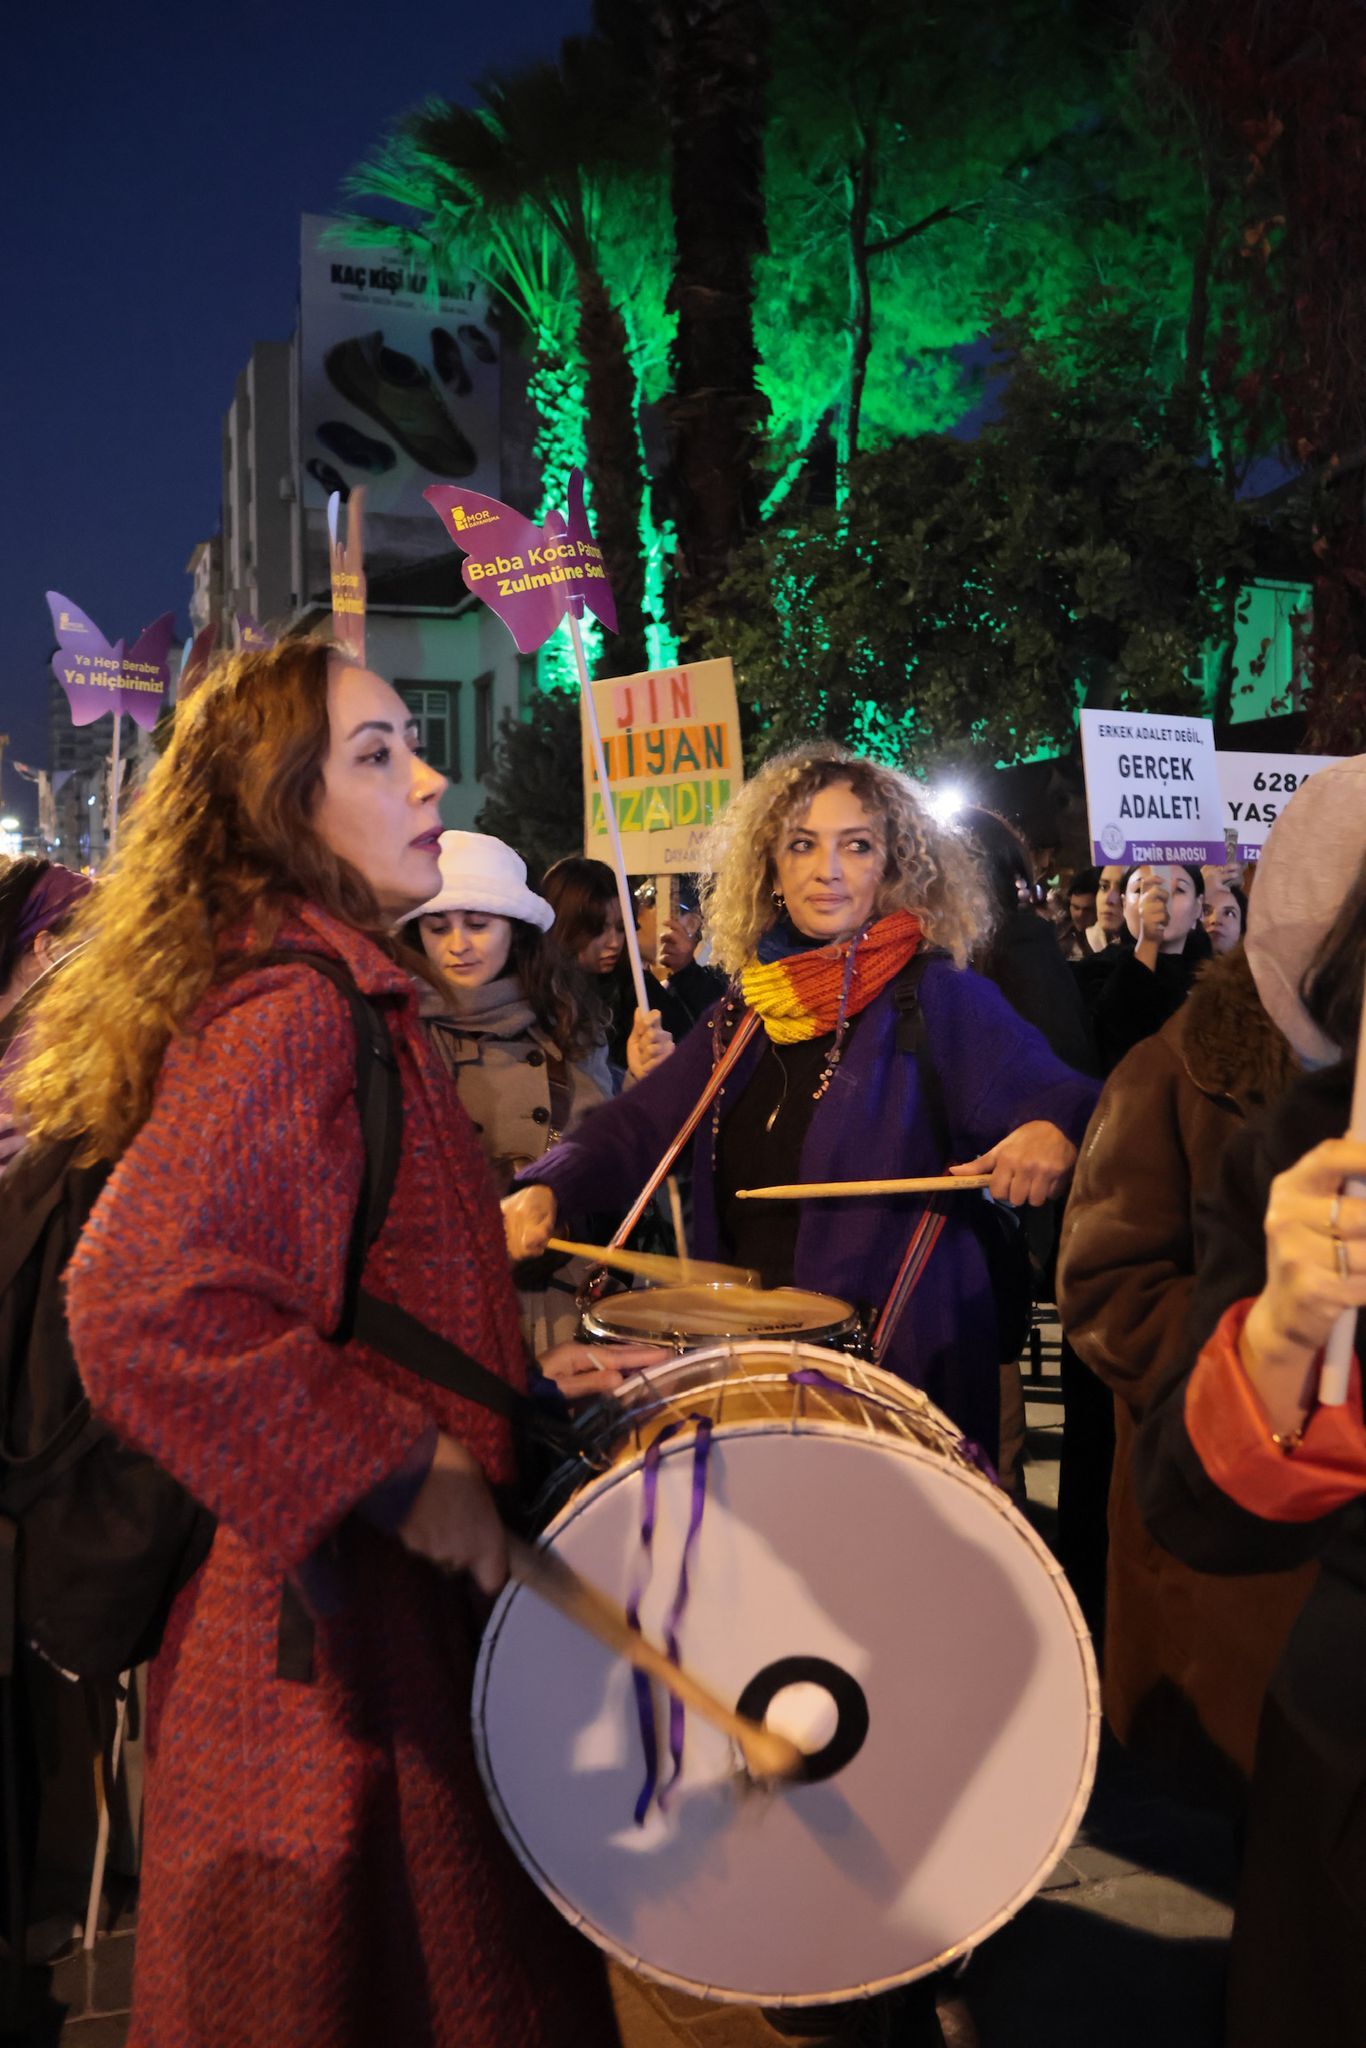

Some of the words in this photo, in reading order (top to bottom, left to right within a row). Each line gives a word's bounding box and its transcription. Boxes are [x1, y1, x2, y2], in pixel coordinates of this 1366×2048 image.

[331, 264, 366, 291] KAÇ
[466, 510, 490, 523] MOR
[467, 554, 524, 581] Baba
[528, 543, 576, 567] Koca
[497, 564, 584, 597] Zulmüne
[64, 669, 85, 685] Ya
[75, 654, 91, 666] Ya
[94, 657, 120, 670] Hep
[122, 659, 160, 675] Beraber
[617, 672, 692, 729] JIN
[1098, 724, 1135, 739] ERKEK
[1136, 727, 1172, 741] ADALET
[1118, 754, 1195, 786] GERÇEK
[1119, 794, 1200, 820] ADALET!
[1132, 843, 1165, 861] İZMİR
[1166, 847, 1207, 862] BAROSU
